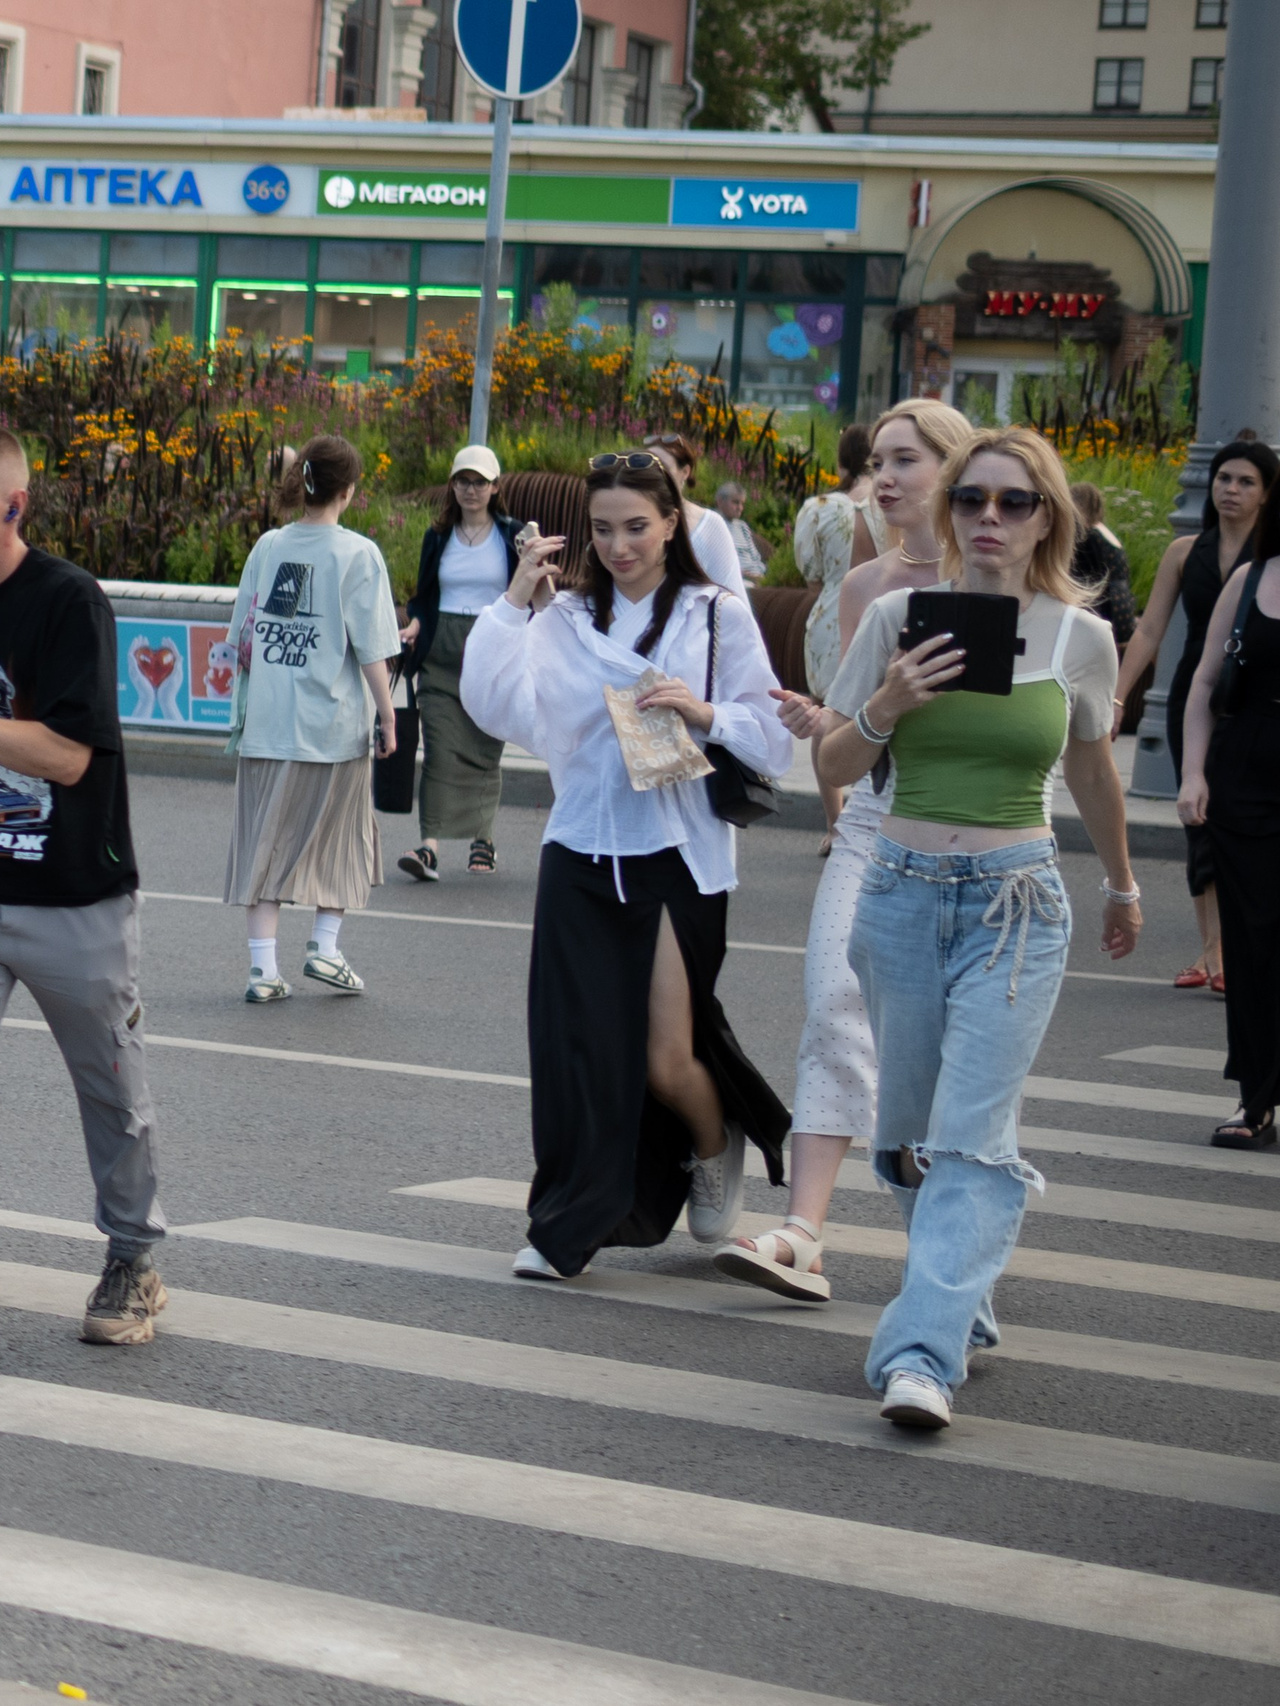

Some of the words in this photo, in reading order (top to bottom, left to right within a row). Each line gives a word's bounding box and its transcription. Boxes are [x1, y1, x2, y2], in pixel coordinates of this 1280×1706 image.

[9, 166, 202, 207] АПТЕКА
[748, 194, 808, 215] YOTA
[255, 621, 320, 649] Book
[284, 622, 309, 631] adidas
[263, 645, 307, 667] Club
[621, 717, 669, 735] cofix
